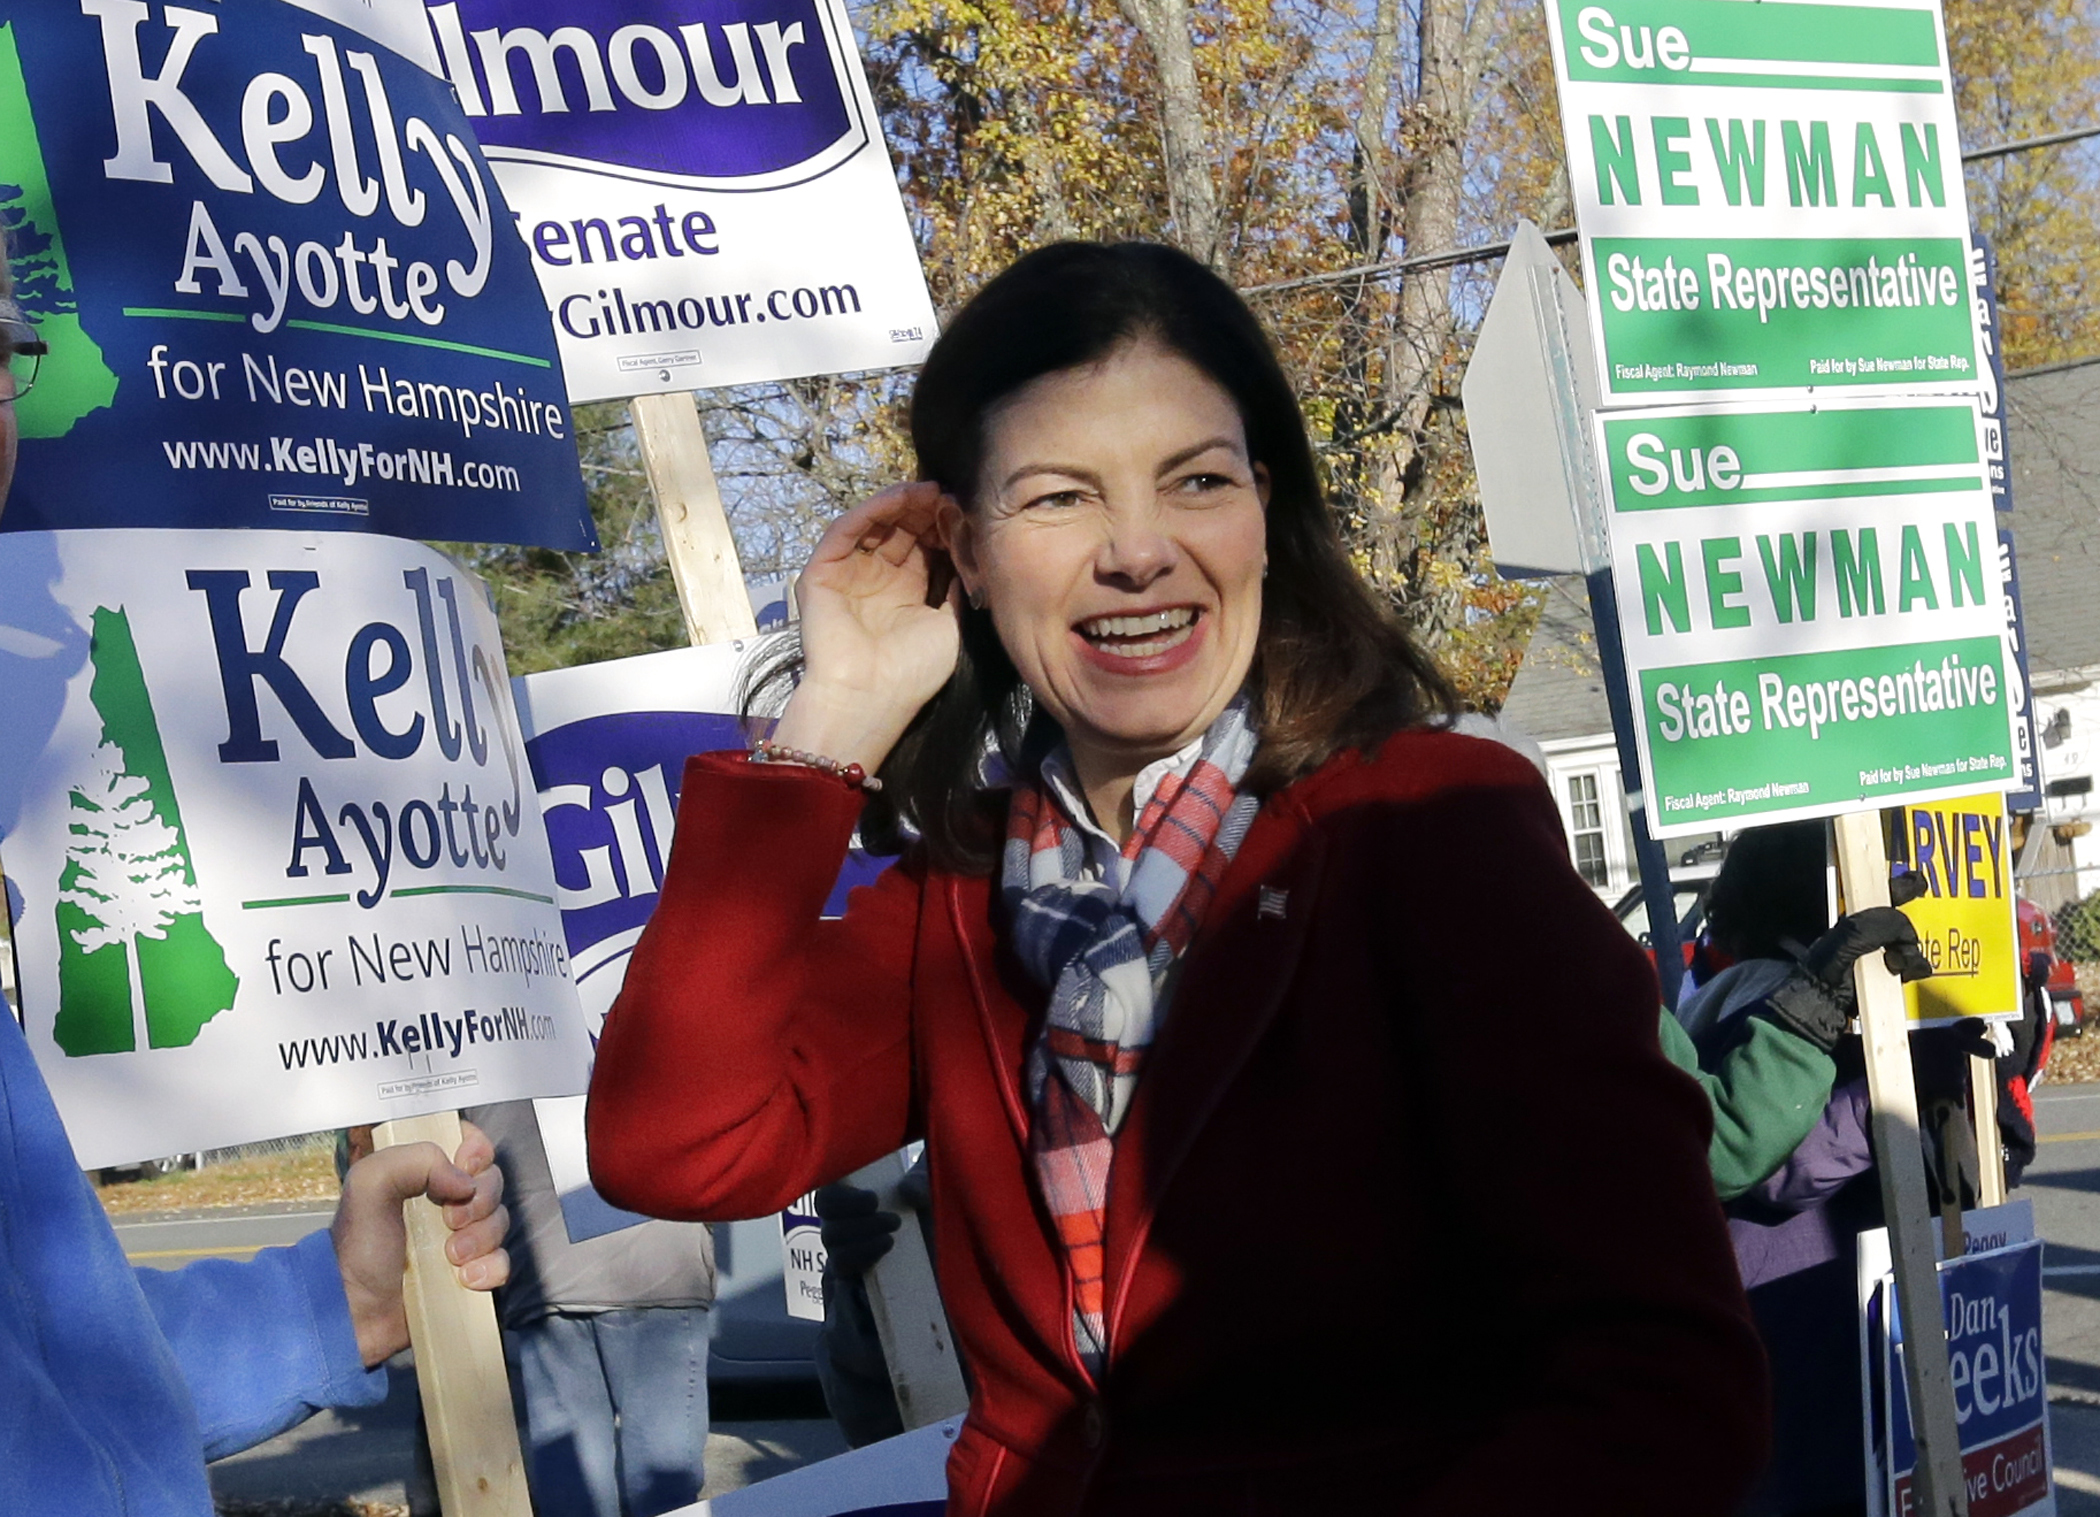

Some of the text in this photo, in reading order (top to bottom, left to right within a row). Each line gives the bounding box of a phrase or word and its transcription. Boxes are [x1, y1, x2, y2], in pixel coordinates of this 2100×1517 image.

[428, 1, 805, 117] lmour
[1577, 7, 1690, 71] Sue
[80, 0, 493, 298] Kelly
[1588, 114, 1946, 208] NEWMAN
[175, 200, 445, 333] Ayotte
[511, 203, 719, 266] enate
[557, 282, 862, 338] Gilmour.com
[1607, 252, 1700, 312] State
[1706, 252, 1959, 323] Representative
[147, 345, 565, 439] for New Hampshire
[1615, 363, 1643, 379] Fiscal
[1676, 362, 1718, 381] Raymond
[1719, 362, 1758, 377] Newman
[1810, 354, 1970, 376] Paid for by Sue Newman for State Rep.
[163, 437, 520, 491] www.KellyForNH.com
[1625, 432, 1742, 497] Sue
[1635, 521, 1986, 636] NEWMAN
[185, 566, 521, 838] Kelly
[1657, 679, 1752, 742] State
[1758, 654, 1997, 740] Representative
[1664, 781, 1810, 812] Fiscal Agent: Raymond Newman
[1859, 769, 1879, 786] Paid
[1879, 768, 1892, 783] for
[1892, 766, 1904, 785] by
[1905, 764, 1921, 779] Sue
[1921, 762, 1956, 777] Newman
[1956, 758, 1968, 773] for
[1969, 756, 1988, 771] State
[286, 777, 507, 909] Ayotte
[537, 763, 679, 911] Gil
[1892, 809, 2002, 898] RVEY
[265, 924, 568, 995] for New Hampshire
[1948, 927, 1981, 977] Rep
[278, 1007, 556, 1070] www.KellyForNH.com
[790, 1248, 826, 1272] NH S
[1950, 1293, 1997, 1341] Dan
[1950, 1304, 2039, 1424] eeks
[1992, 1437, 2043, 1492] Council
